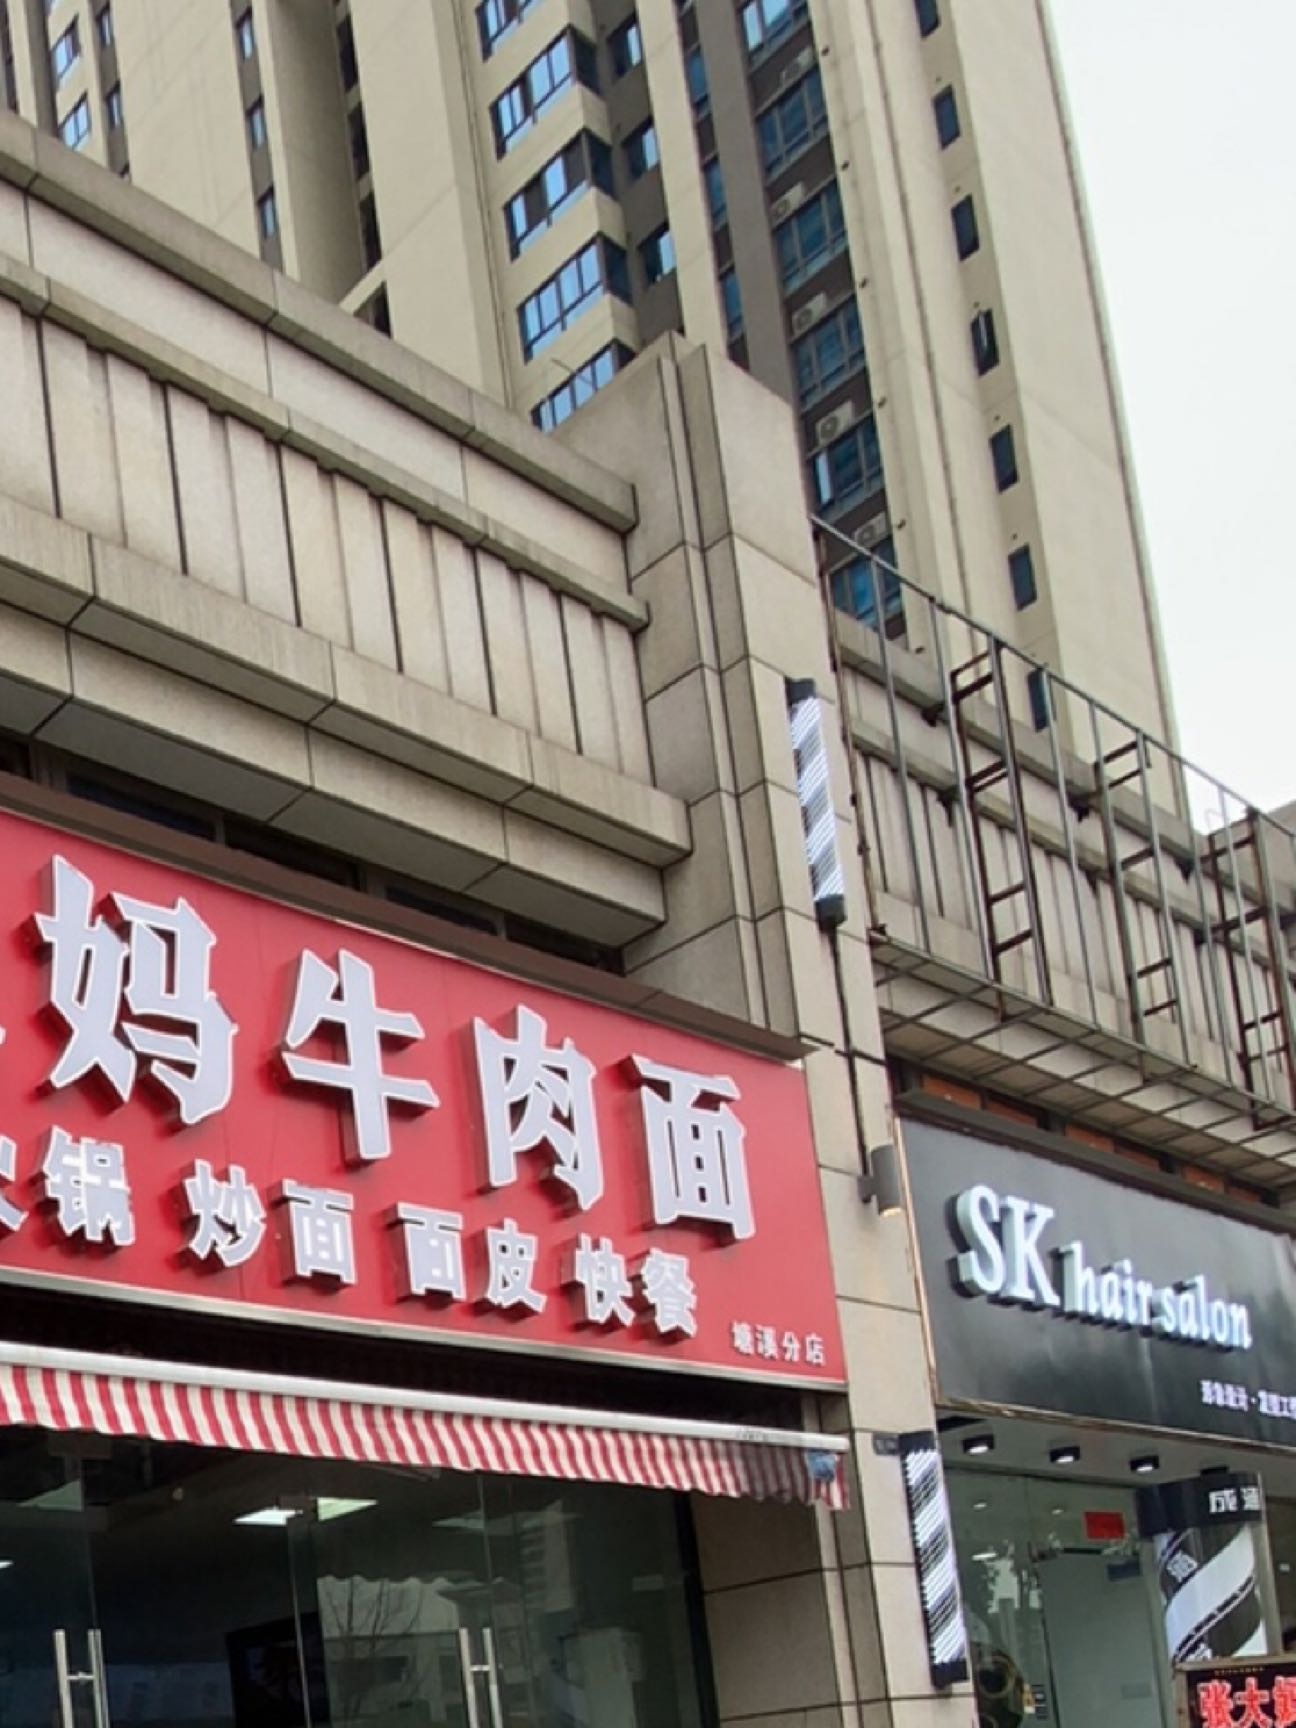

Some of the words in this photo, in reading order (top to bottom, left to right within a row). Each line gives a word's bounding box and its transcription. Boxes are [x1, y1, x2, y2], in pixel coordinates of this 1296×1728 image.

[184, 1159, 357, 1284] 炒面
[573, 1232, 697, 1337] 快餐
[957, 1185, 1060, 1306] SK
[1061, 1240, 1154, 1326] hair
[1155, 1275, 1253, 1350] salon
